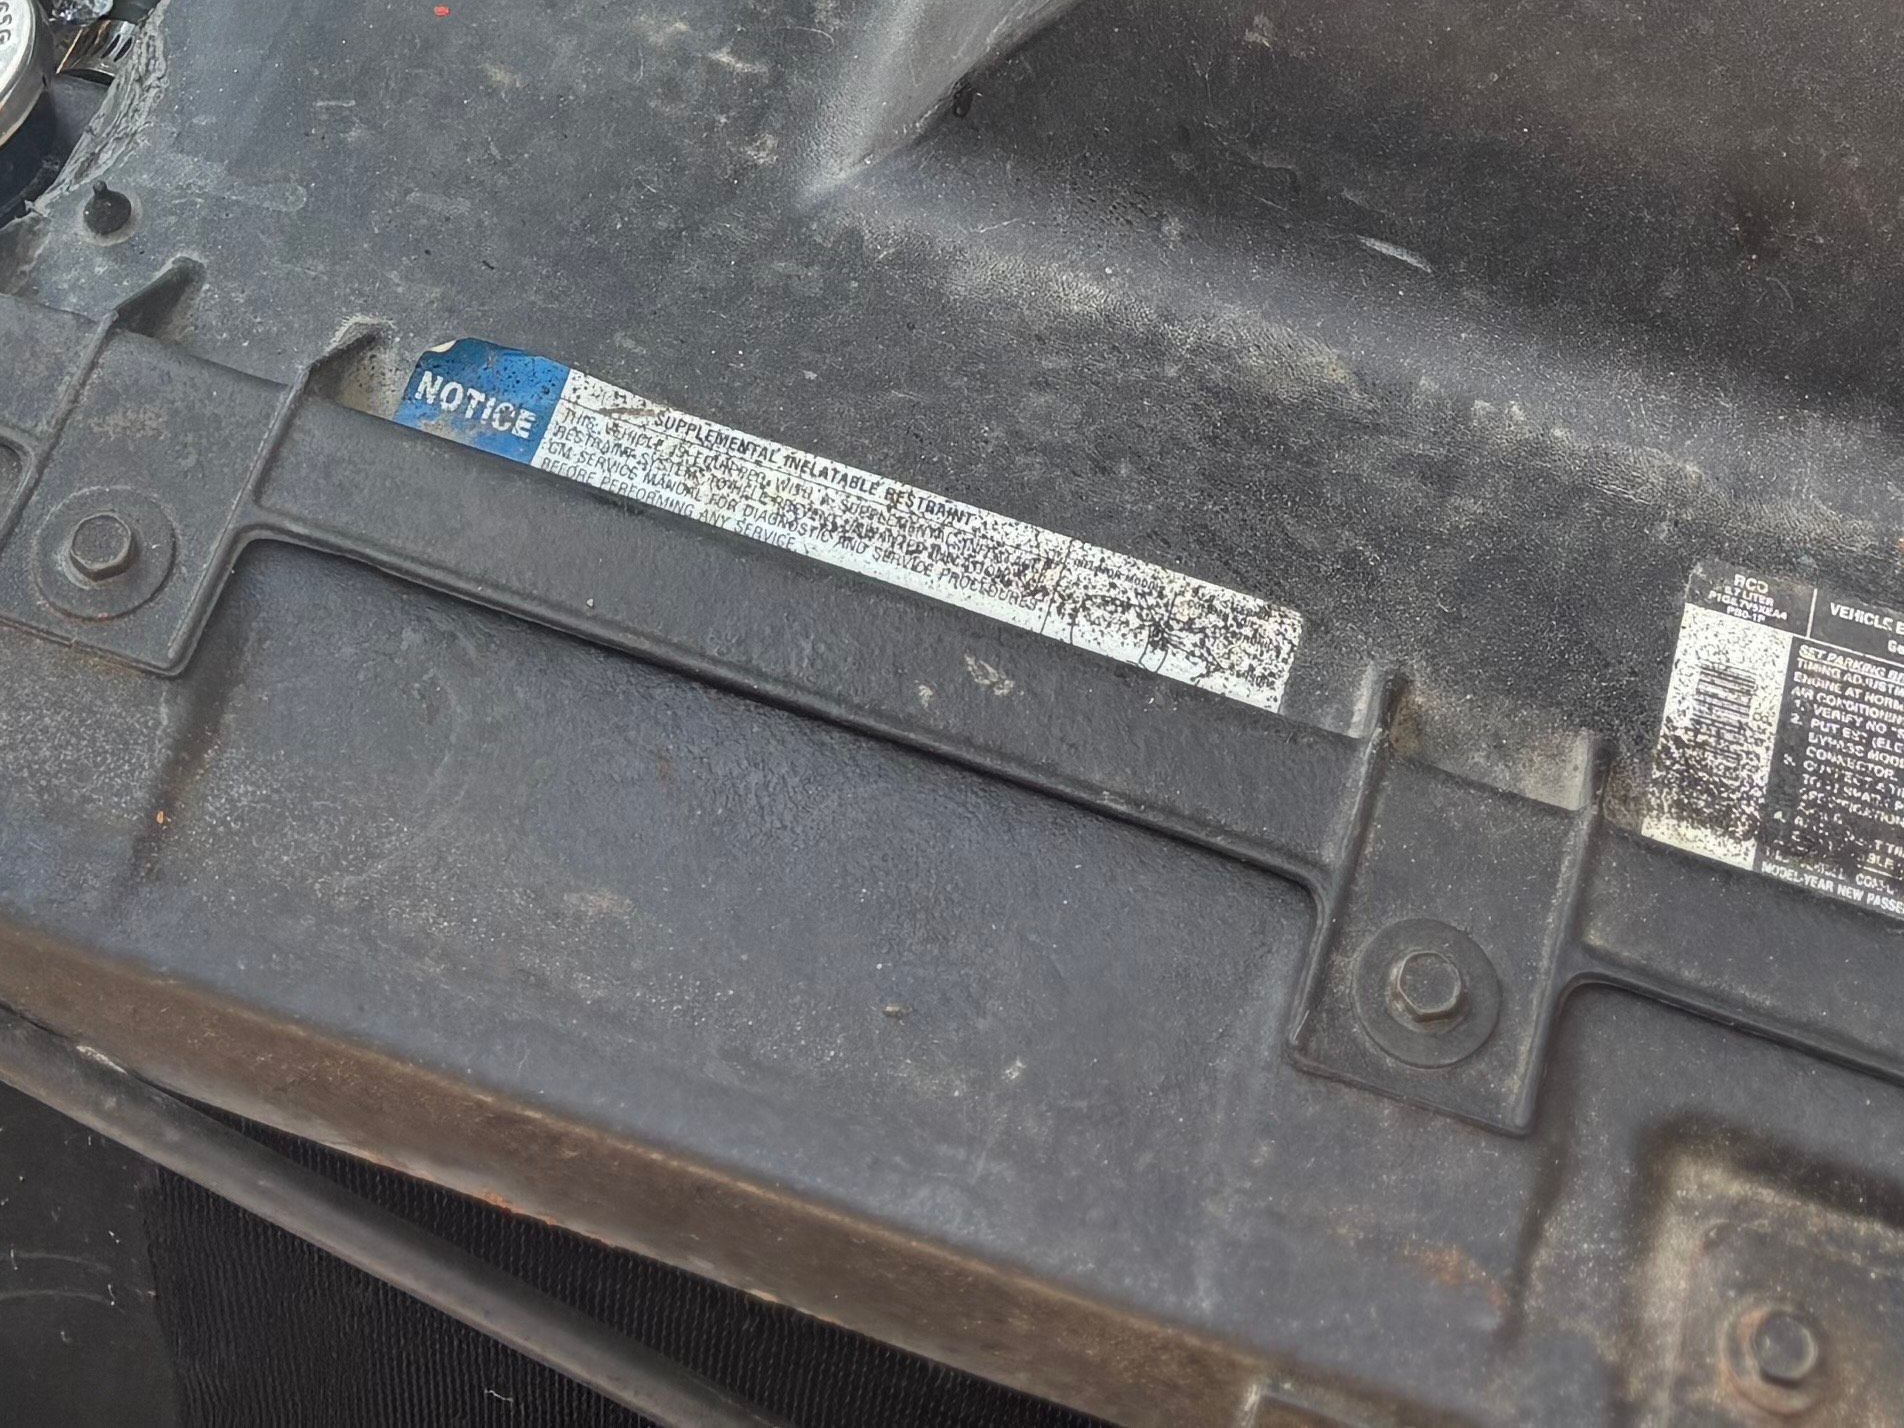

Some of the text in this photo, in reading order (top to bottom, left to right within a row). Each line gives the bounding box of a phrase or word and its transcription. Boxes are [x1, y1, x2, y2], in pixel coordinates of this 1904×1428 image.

[413, 369, 538, 440] NOTICE
[653, 411, 779, 465] SUPPLEMENTAL
[577, 449, 639, 480] SERVICE
[707, 492, 738, 512] FOR
[835, 534, 867, 555] AND
[871, 546, 934, 577] SERVICE
[599, 475, 694, 517] PERFORMING
[698, 508, 729, 528] ANY
[1827, 602, 1893, 631] VEHICLE
[1826, 652, 1886, 679] PARKING
[1844, 685, 1863, 700] AT
[1809, 717, 1839, 735] PUT
[1811, 703, 1863, 728] VERIFY
[1865, 719, 1888, 735] NO
[1760, 861, 1834, 893] MODEL-YEAR
[1836, 884, 1863, 901] NEW
